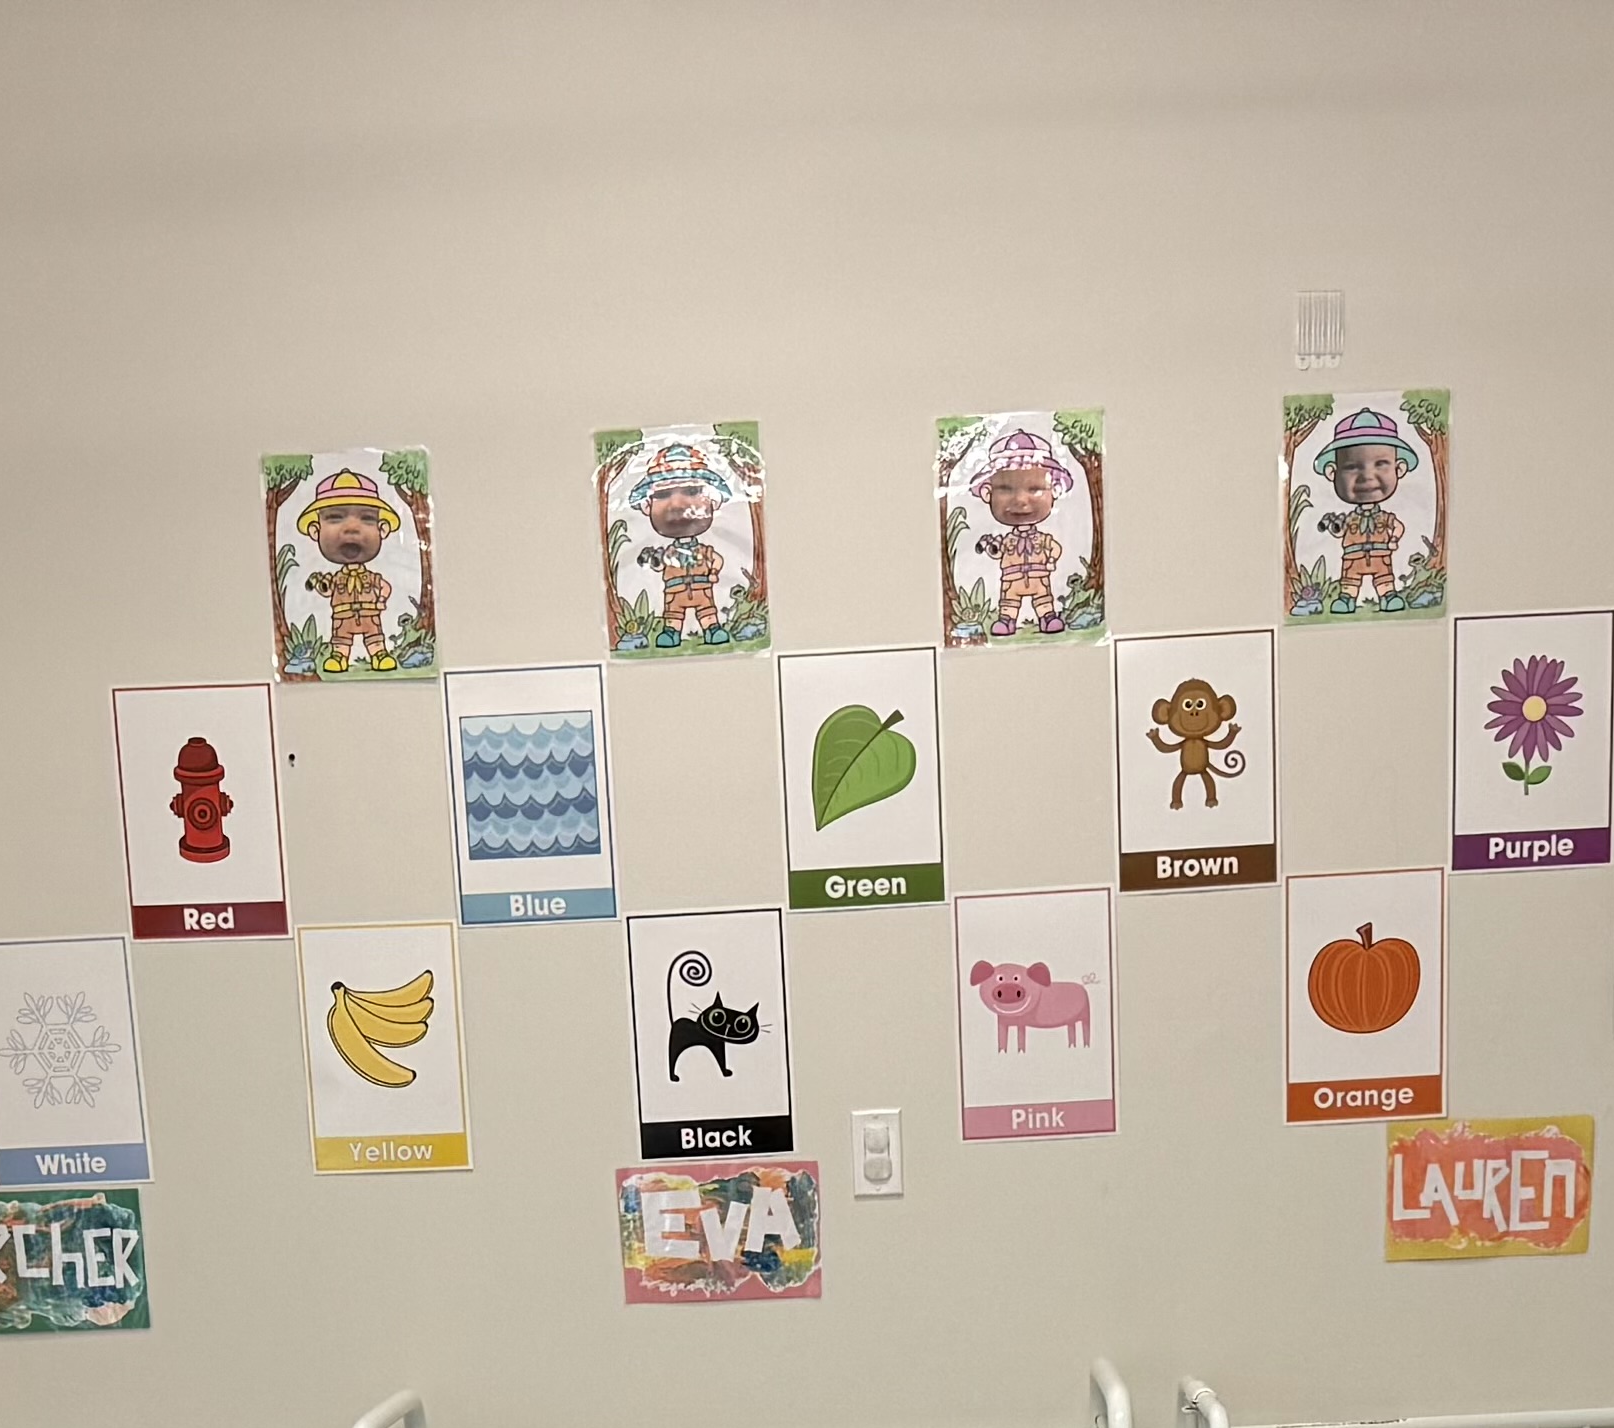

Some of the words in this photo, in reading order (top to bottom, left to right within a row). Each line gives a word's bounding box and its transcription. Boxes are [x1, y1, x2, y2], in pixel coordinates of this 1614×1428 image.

[1488, 834, 1574, 862] Purple
[1156, 855, 1239, 879] Brown
[824, 875, 907, 899] Green
[509, 894, 567, 917] Blue
[183, 906, 235, 931] Red
[1313, 1087, 1414, 1112] Orange
[1011, 1107, 1065, 1130] Pink
[680, 1125, 752, 1150] Black
[35, 1152, 107, 1176] White
[349, 1141, 432, 1163] Yellow
[640, 1185, 802, 1262] EVA
